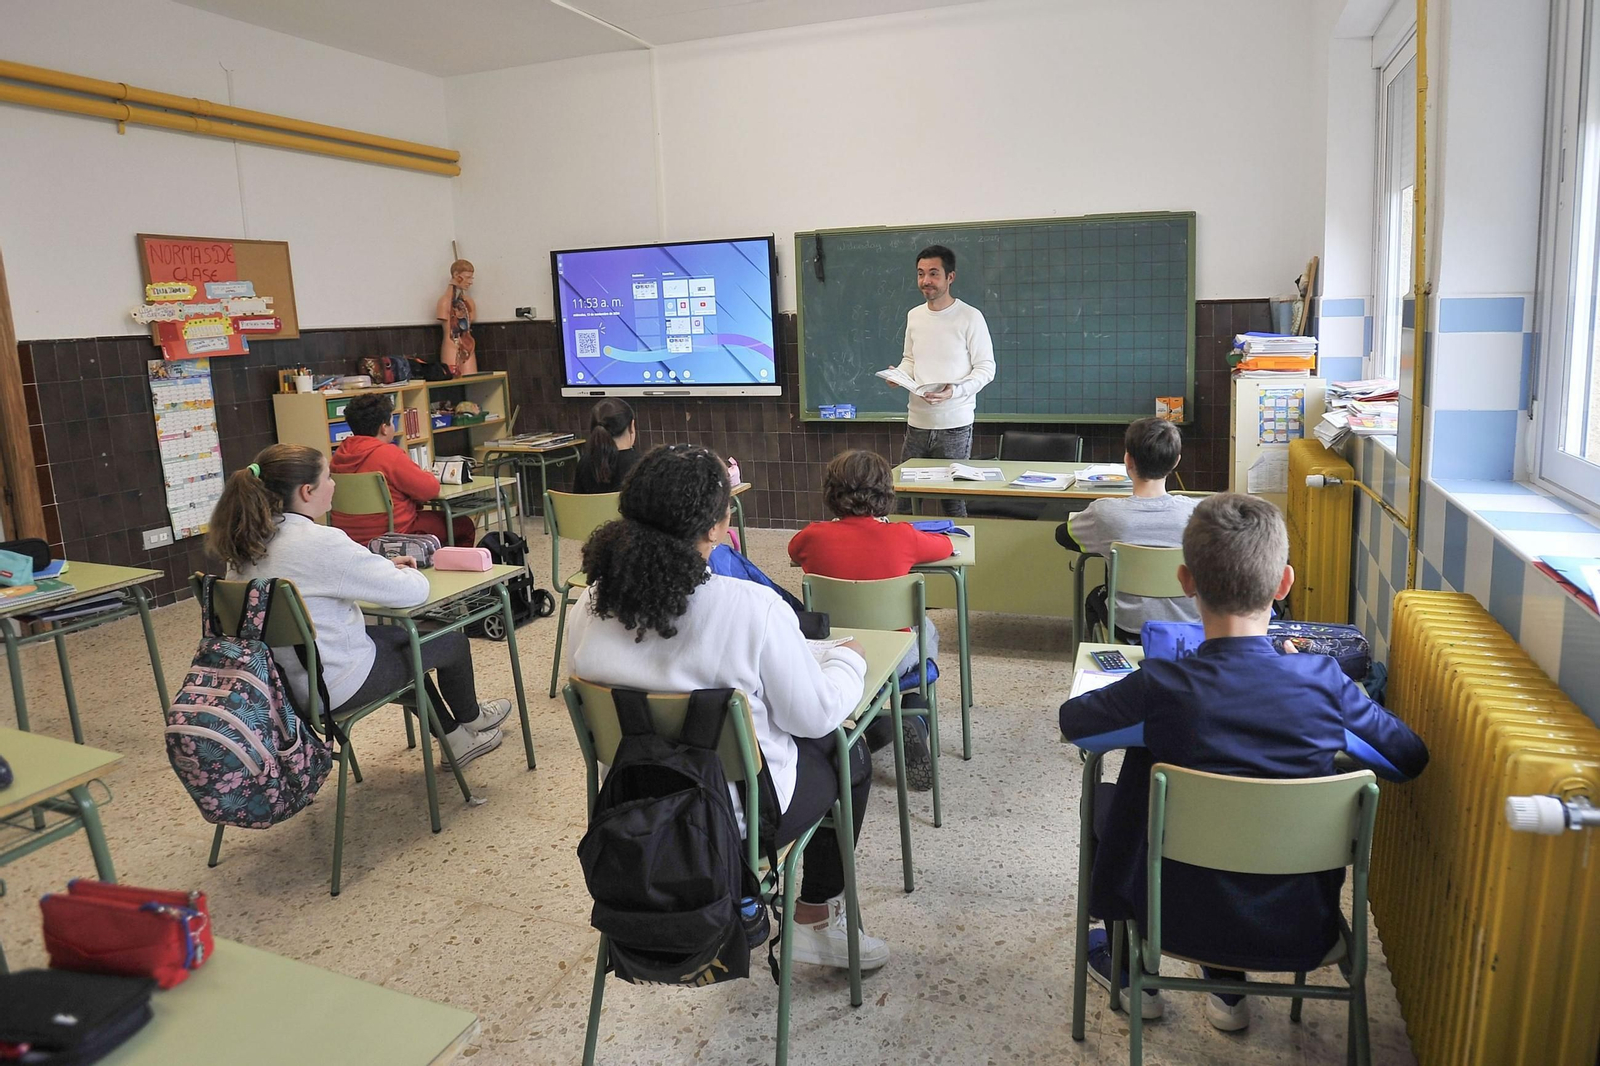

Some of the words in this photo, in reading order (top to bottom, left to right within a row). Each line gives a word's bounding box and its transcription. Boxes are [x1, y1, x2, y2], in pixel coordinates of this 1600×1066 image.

[149, 244, 212, 265] NORMAS
[211, 244, 235, 265] DE
[172, 267, 219, 283] CLASE
[572, 297, 598, 309] 11:53
[600, 299, 609, 308] a.
[611, 298, 624, 307] m.
